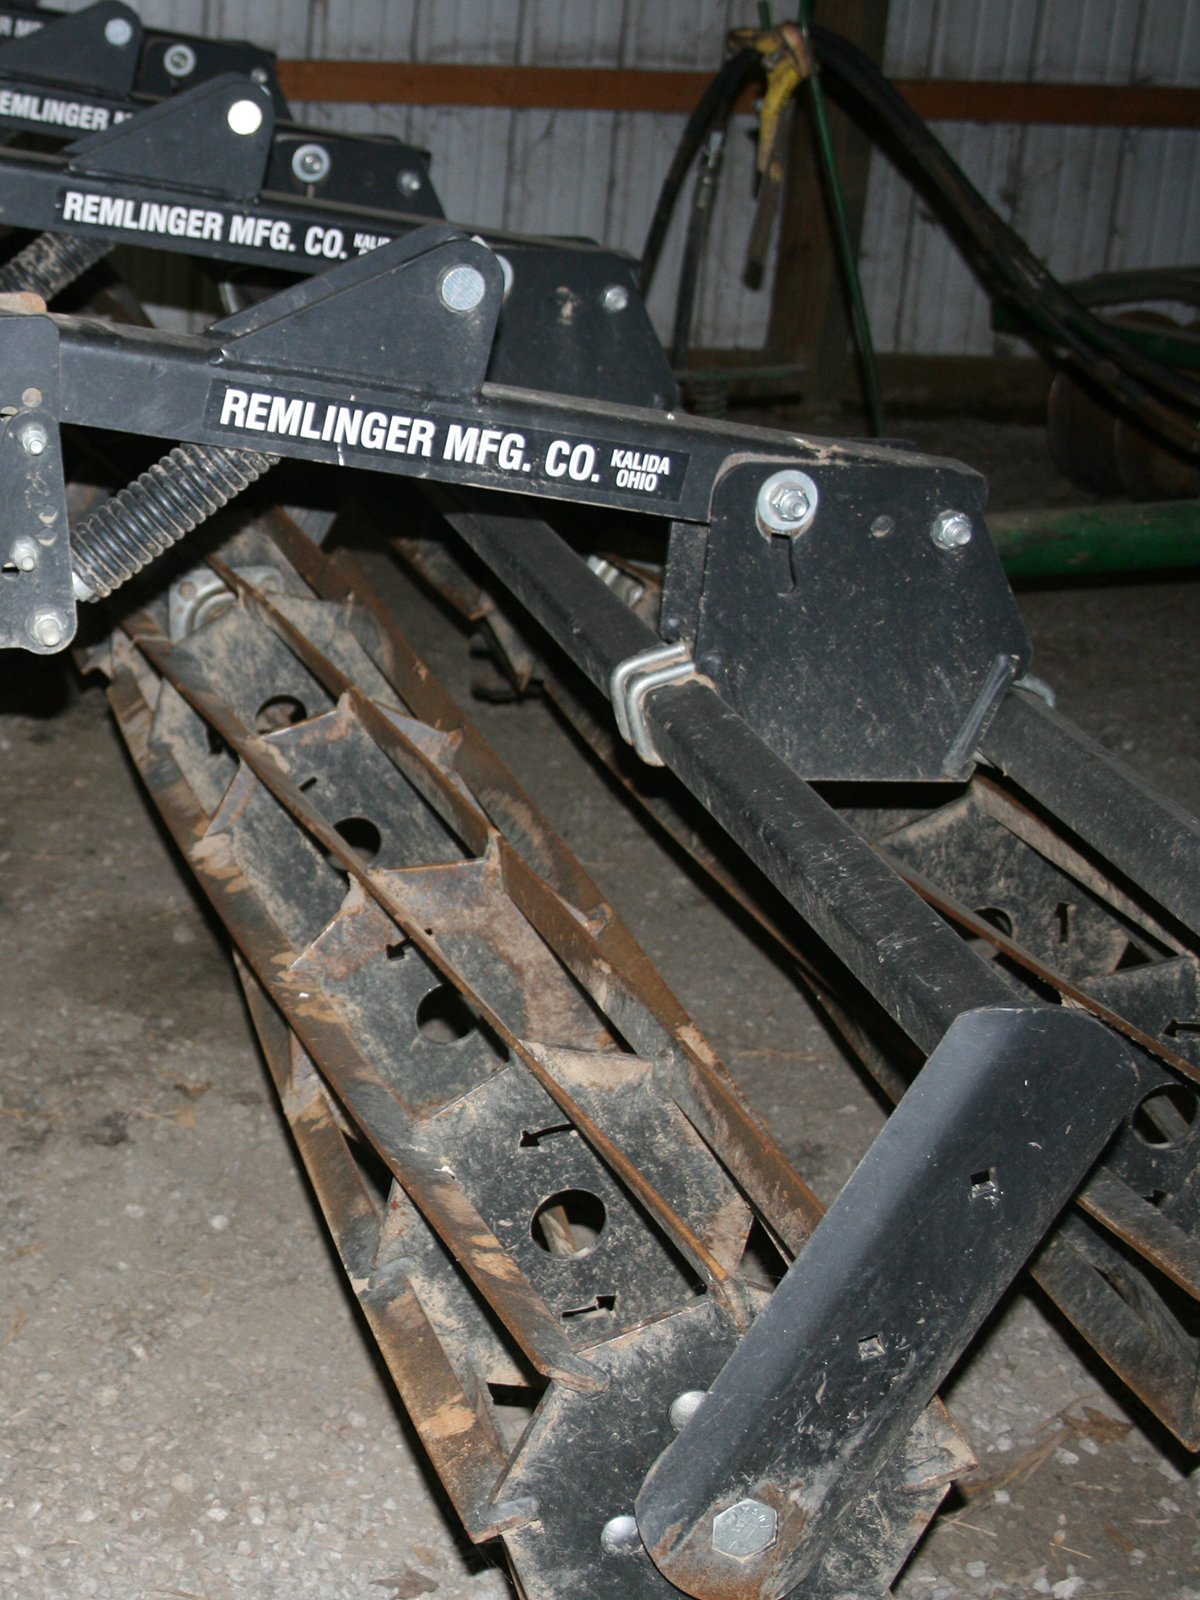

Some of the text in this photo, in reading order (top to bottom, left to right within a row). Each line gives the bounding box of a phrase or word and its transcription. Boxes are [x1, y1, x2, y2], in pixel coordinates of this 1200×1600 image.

[63, 191, 224, 241] REMLINGER
[228, 215, 297, 252] MFG.
[304, 226, 348, 260] CO.
[220, 388, 670, 483] REMLINGER MFG. CO. KALIDA
[616, 470, 657, 492] OHIO
